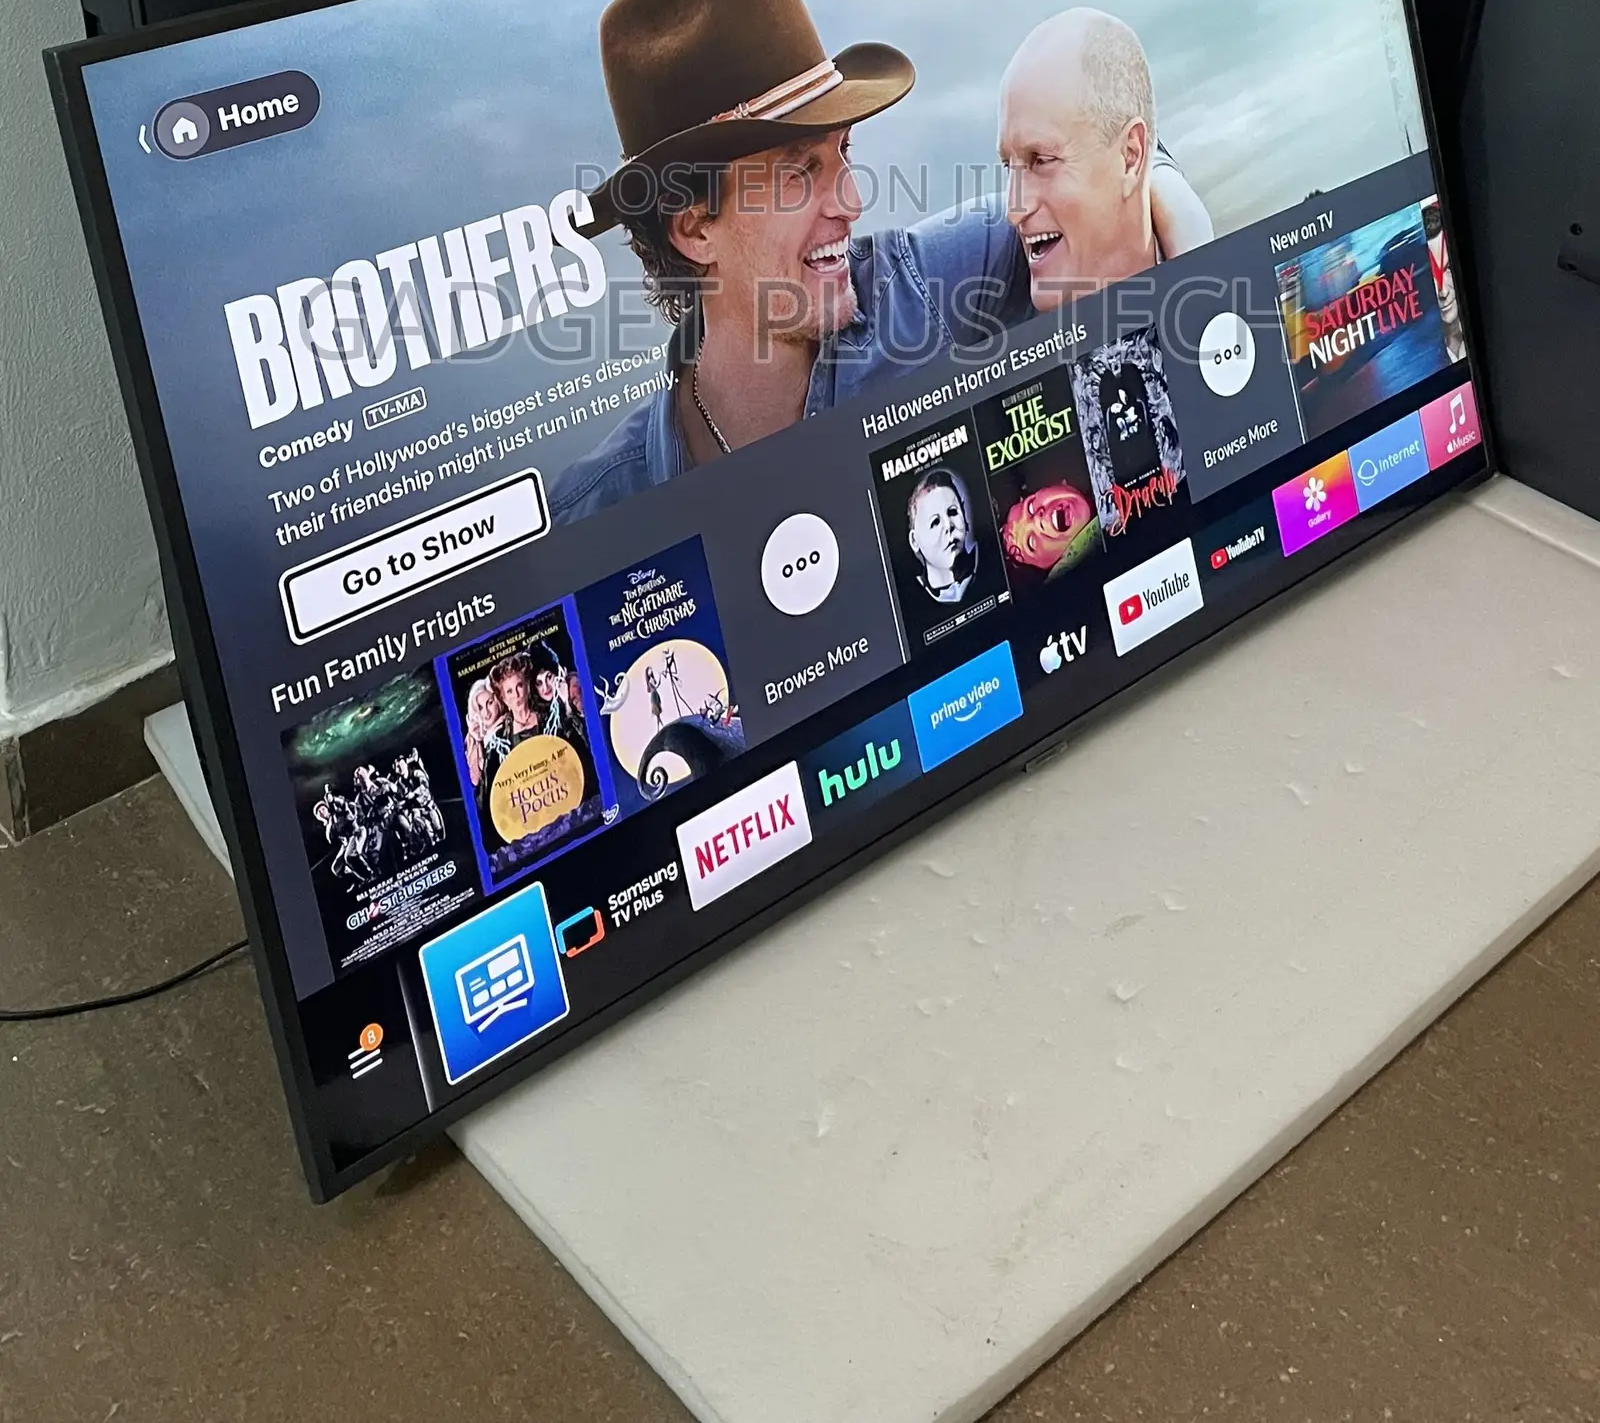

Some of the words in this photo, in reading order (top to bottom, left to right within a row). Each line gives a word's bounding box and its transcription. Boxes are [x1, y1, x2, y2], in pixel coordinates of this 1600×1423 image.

[218, 93, 299, 131] Home
[1270, 229, 1298, 254] New
[1300, 221, 1317, 239] on
[1317, 211, 1333, 232] TV
[224, 189, 606, 429] BROTHERS
[1305, 264, 1416, 339] SATURDAY
[1308, 311, 1376, 369] NIGHT
[1374, 290, 1423, 335] LIVE
[862, 386, 953, 439] Halloween
[954, 359, 1006, 396] Horror
[1009, 323, 1087, 371] Essentials
[268, 484, 315, 513] Two
[319, 468, 341, 493] of
[345, 422, 468, 483] Hollywood's
[471, 390, 542, 433] biggest
[547, 374, 592, 403] stars
[595, 342, 668, 383] discover
[368, 394, 422, 424] TV-MA
[1005, 395, 1046, 430] THE
[259, 419, 353, 468] Comedy
[275, 512, 325, 546] their
[330, 470, 434, 524] friendship
[438, 442, 494, 480] might
[497, 427, 533, 460] just
[536, 416, 568, 439] run
[570, 405, 588, 425] in
[590, 392, 621, 417] the
[623, 369, 679, 404] family.
[881, 425, 969, 481] HALLOWEEN
[986, 407, 1072, 471] EXORCIST
[1203, 439, 1247, 468] Browse
[1248, 418, 1278, 445] More
[1378, 438, 1420, 473] Internet
[1451, 430, 1476, 451] Music
[1307, 509, 1332, 529] Gallery
[343, 566, 381, 595] Go
[387, 551, 416, 576] to
[422, 515, 494, 561] Show
[1143, 571, 1190, 610] YouTube
[637, 598, 696, 638] CHRISTMAS
[271, 672, 321, 712] Fun
[324, 633, 407, 688] Family
[411, 593, 496, 647] Frights
[1058, 625, 1087, 663] tv
[764, 659, 825, 705] Browse
[826, 637, 869, 671] More
[929, 693, 966, 729] prime
[967, 675, 1000, 705] video
[510, 769, 559, 808] HOCUS
[818, 738, 902, 807] hulu
[520, 782, 569, 823] POCUS
[693, 794, 796, 880] NETFLIX
[608, 861, 678, 911] Samsung
[611, 900, 632, 927] TV
[635, 888, 665, 917] Plus
